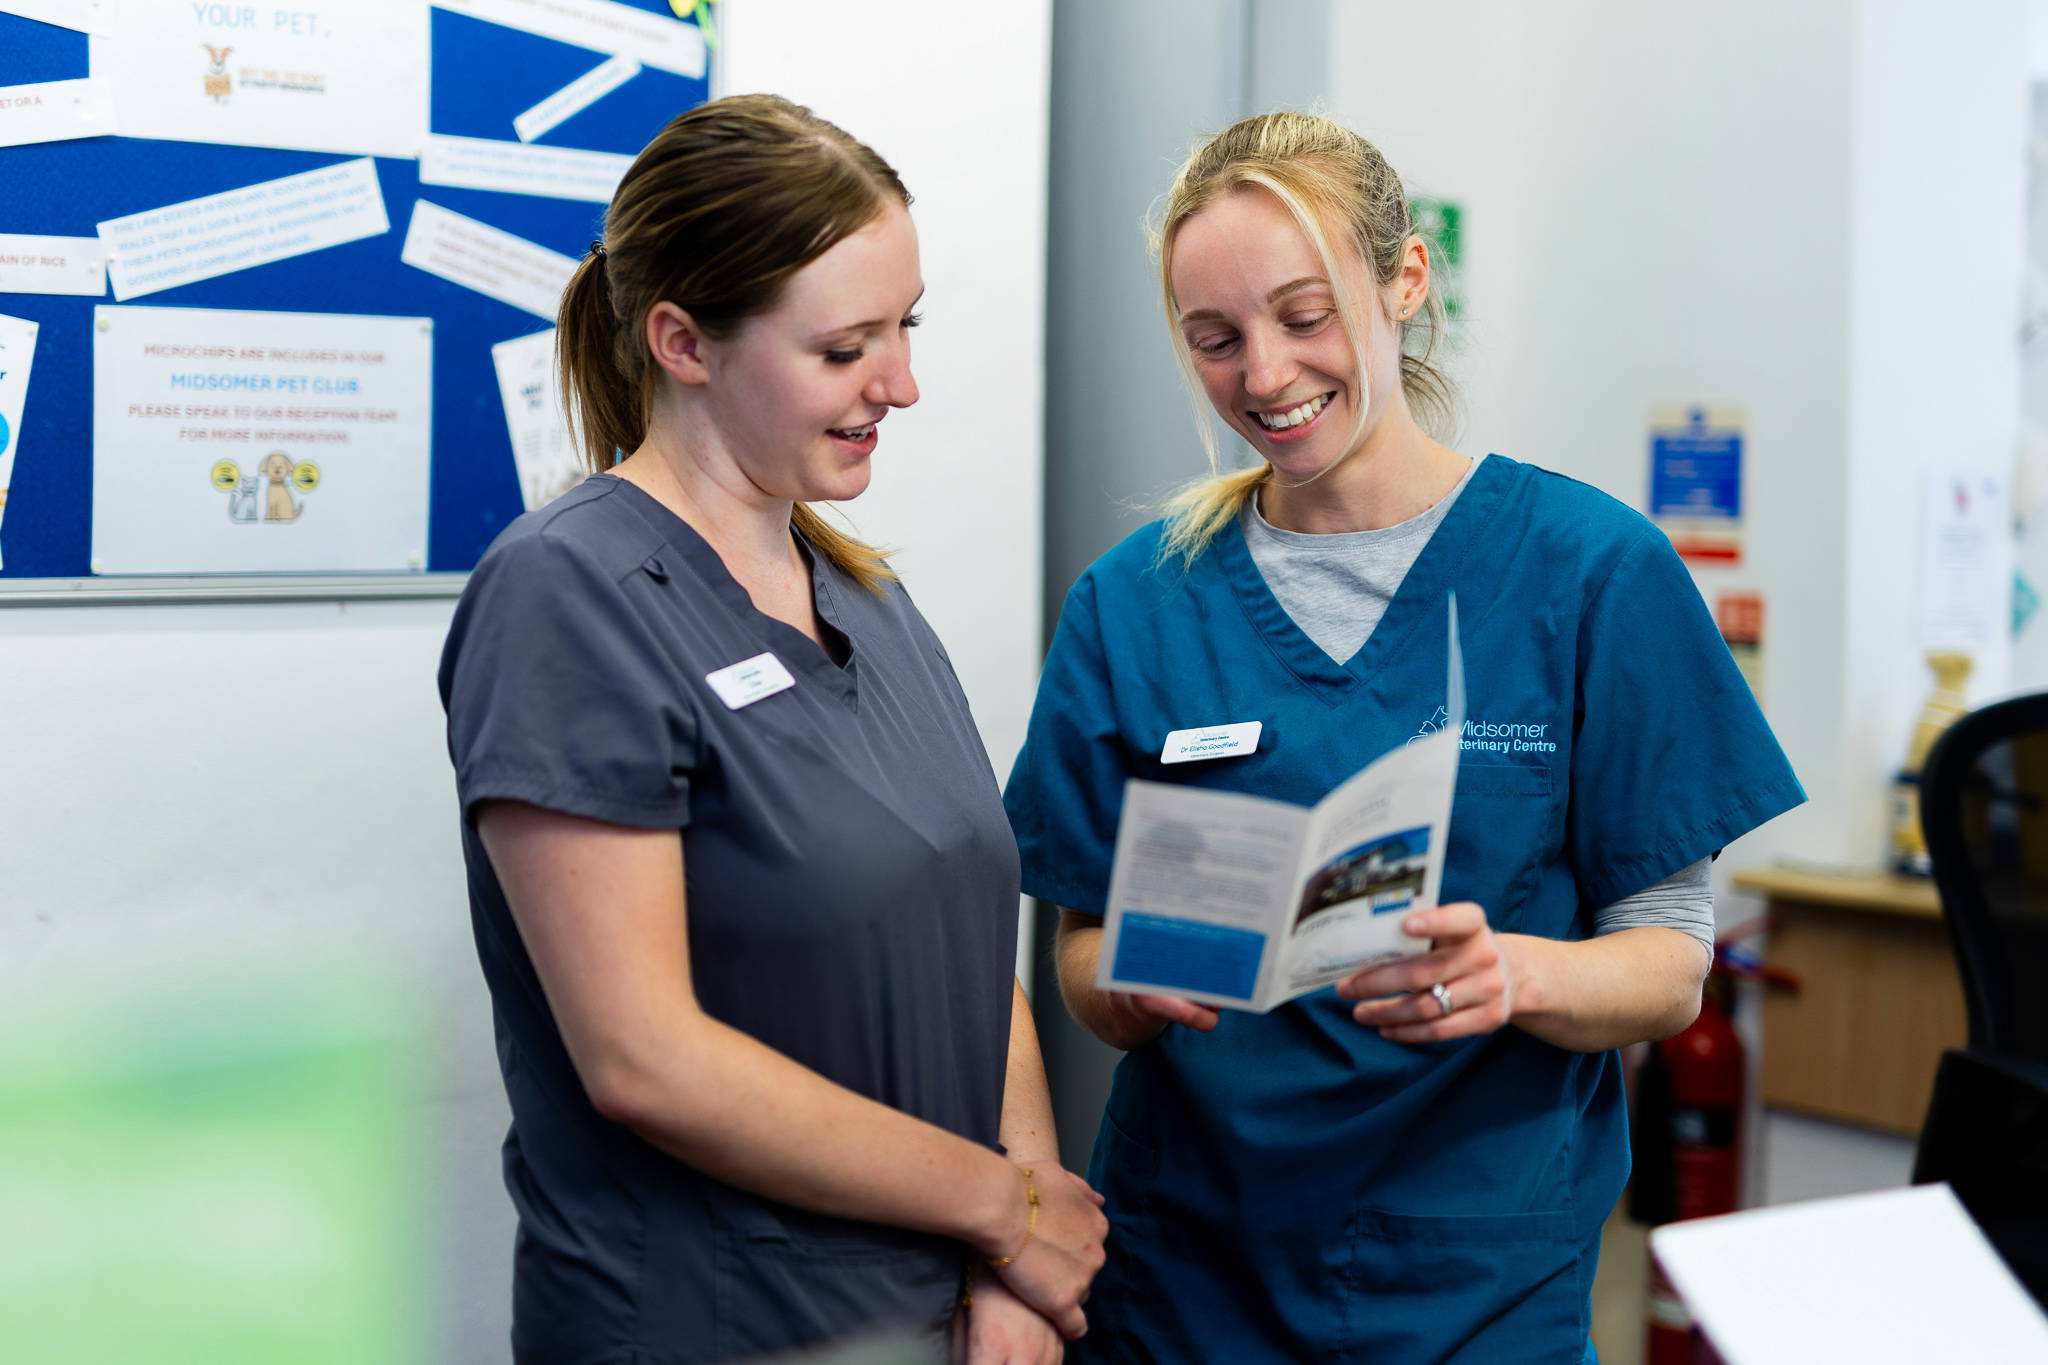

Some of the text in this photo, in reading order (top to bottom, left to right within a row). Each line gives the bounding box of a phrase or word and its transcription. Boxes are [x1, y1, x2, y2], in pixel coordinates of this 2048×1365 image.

[192, 1, 256, 29] YOUR
[170, 373, 272, 391] MIDSOMER
[276, 375, 310, 392] PET
[128, 403, 182, 417] PLEASE
[184, 405, 229, 418] SPEAK
[1456, 738, 1557, 753] terinary Centre
